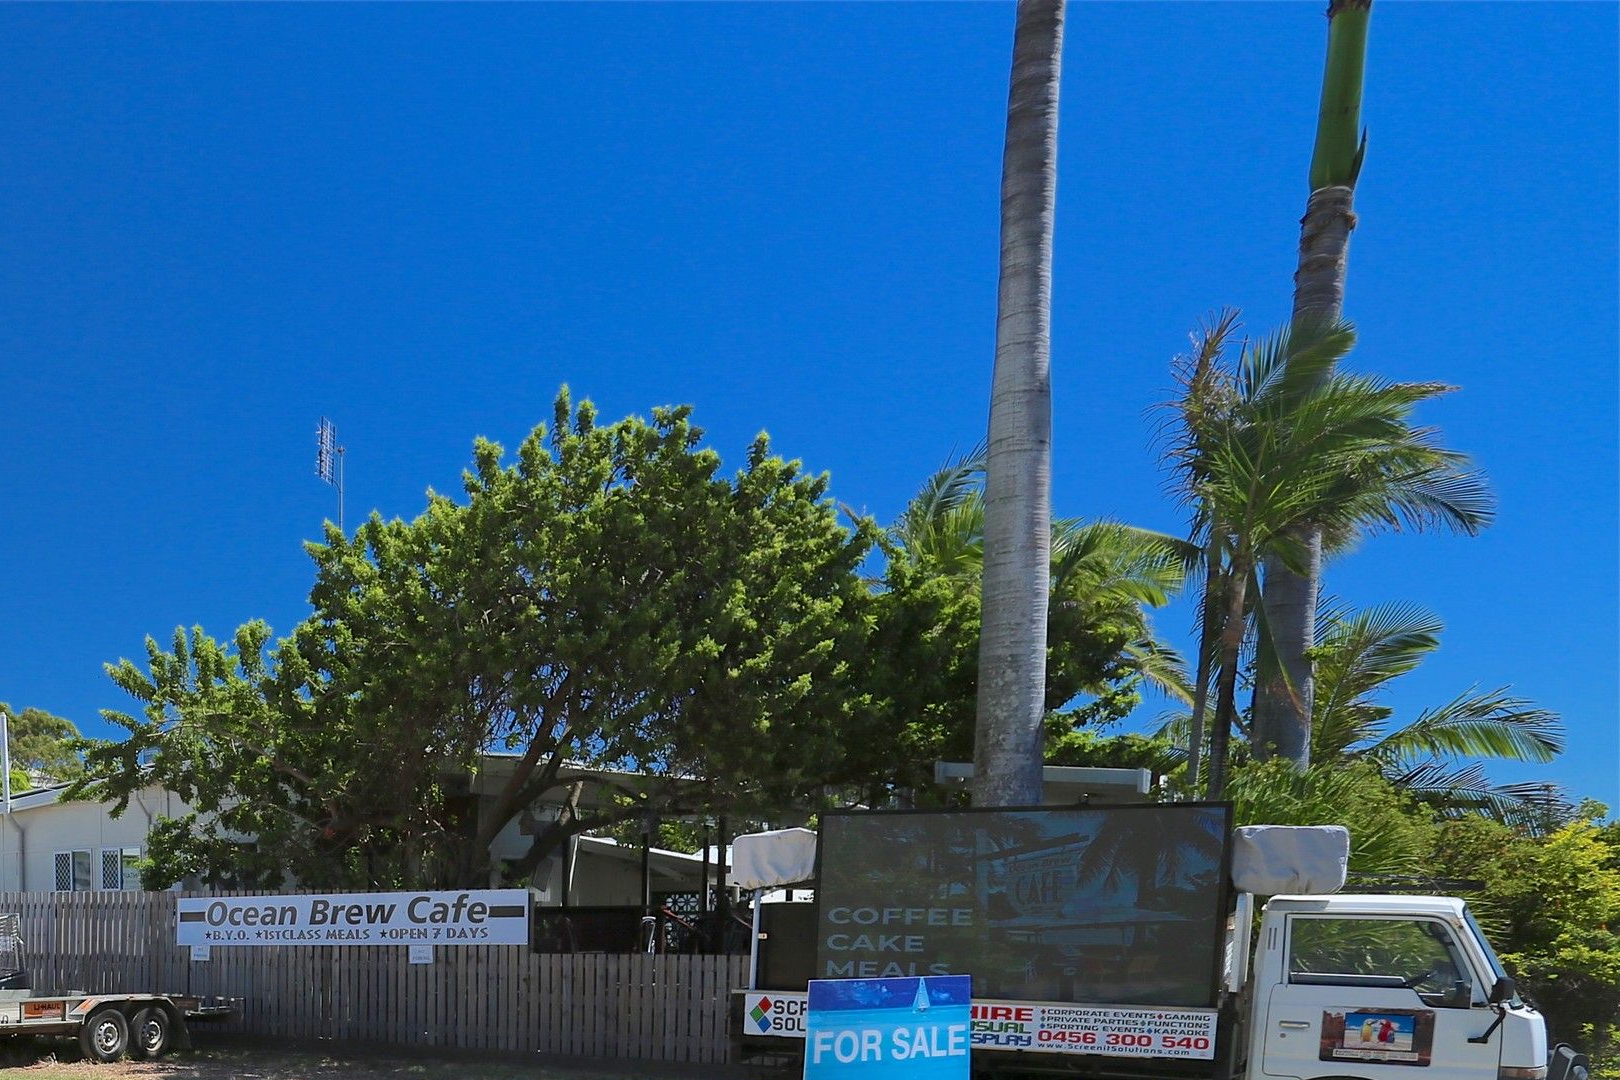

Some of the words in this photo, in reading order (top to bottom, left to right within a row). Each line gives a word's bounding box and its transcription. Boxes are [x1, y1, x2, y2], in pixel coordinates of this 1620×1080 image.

[207, 901, 298, 926] Ocean
[309, 899, 396, 926] Brew
[407, 893, 488, 924] Cafe
[828, 907, 973, 926] COFFEE
[326, 929, 370, 940] MEALS
[389, 928, 428, 939] OPEN
[432, 928, 442, 939] 7
[446, 927, 488, 939] DAYS
[826, 934, 924, 953] CAKE
[1047, 1009, 1110, 1017] CORPORATE
[1113, 1011, 1156, 1019] EVENTS
[1164, 1013, 1211, 1021] GAMING
[1047, 1016, 1091, 1024] PRIVATE
[1093, 1018, 1139, 1026] PARTIES
[1147, 1021, 1210, 1029] FUNCTIONS
[1046, 1023, 1099, 1031] SPORTING
[1154, 1028, 1209, 1036] KARAOKE
[813, 1030, 882, 1064] FOR
[891, 1024, 966, 1061] SALE
[1037, 1030, 1096, 1044] 0456
[1105, 1034, 1152, 1047] 300
[1161, 1036, 1209, 1050] 540
